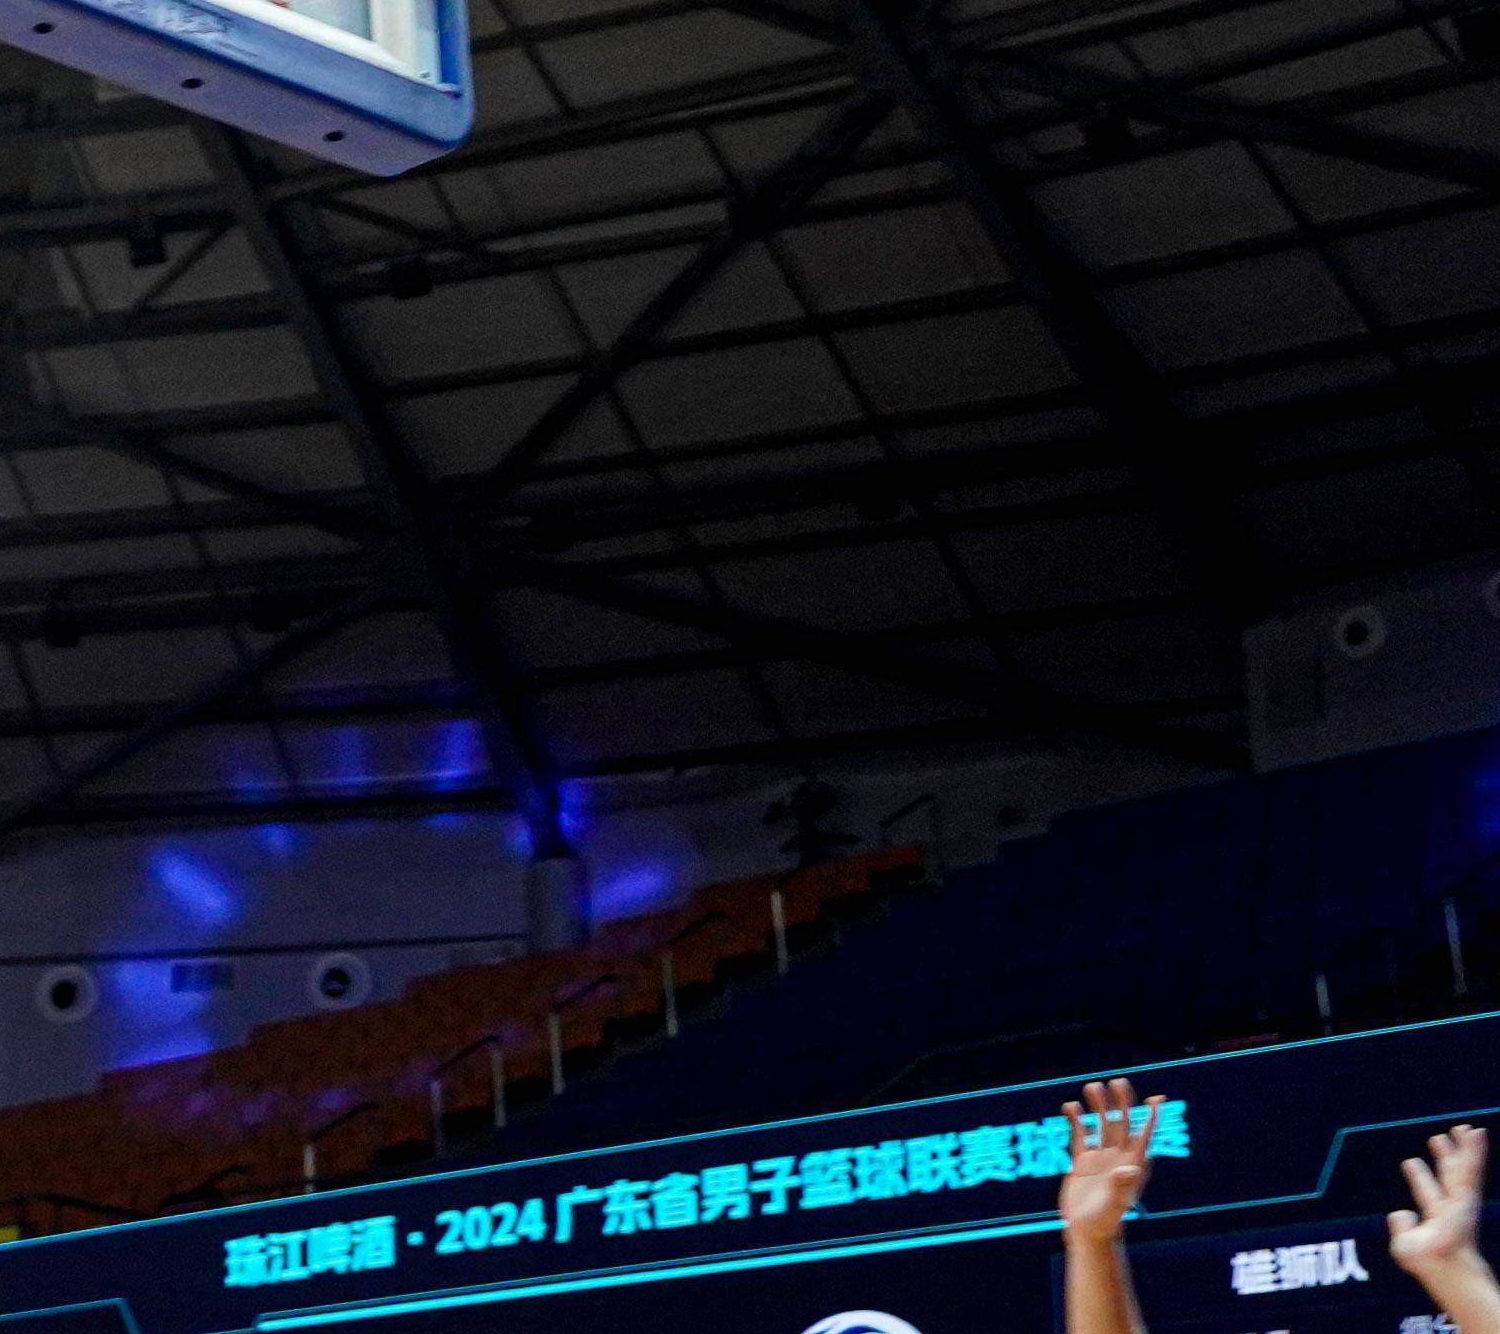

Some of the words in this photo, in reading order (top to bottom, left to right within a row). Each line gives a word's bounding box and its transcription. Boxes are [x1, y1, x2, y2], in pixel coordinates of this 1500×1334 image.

[224, 1215, 396, 1288] 珠江啤酒
[435, 1196, 546, 1255] 2024
